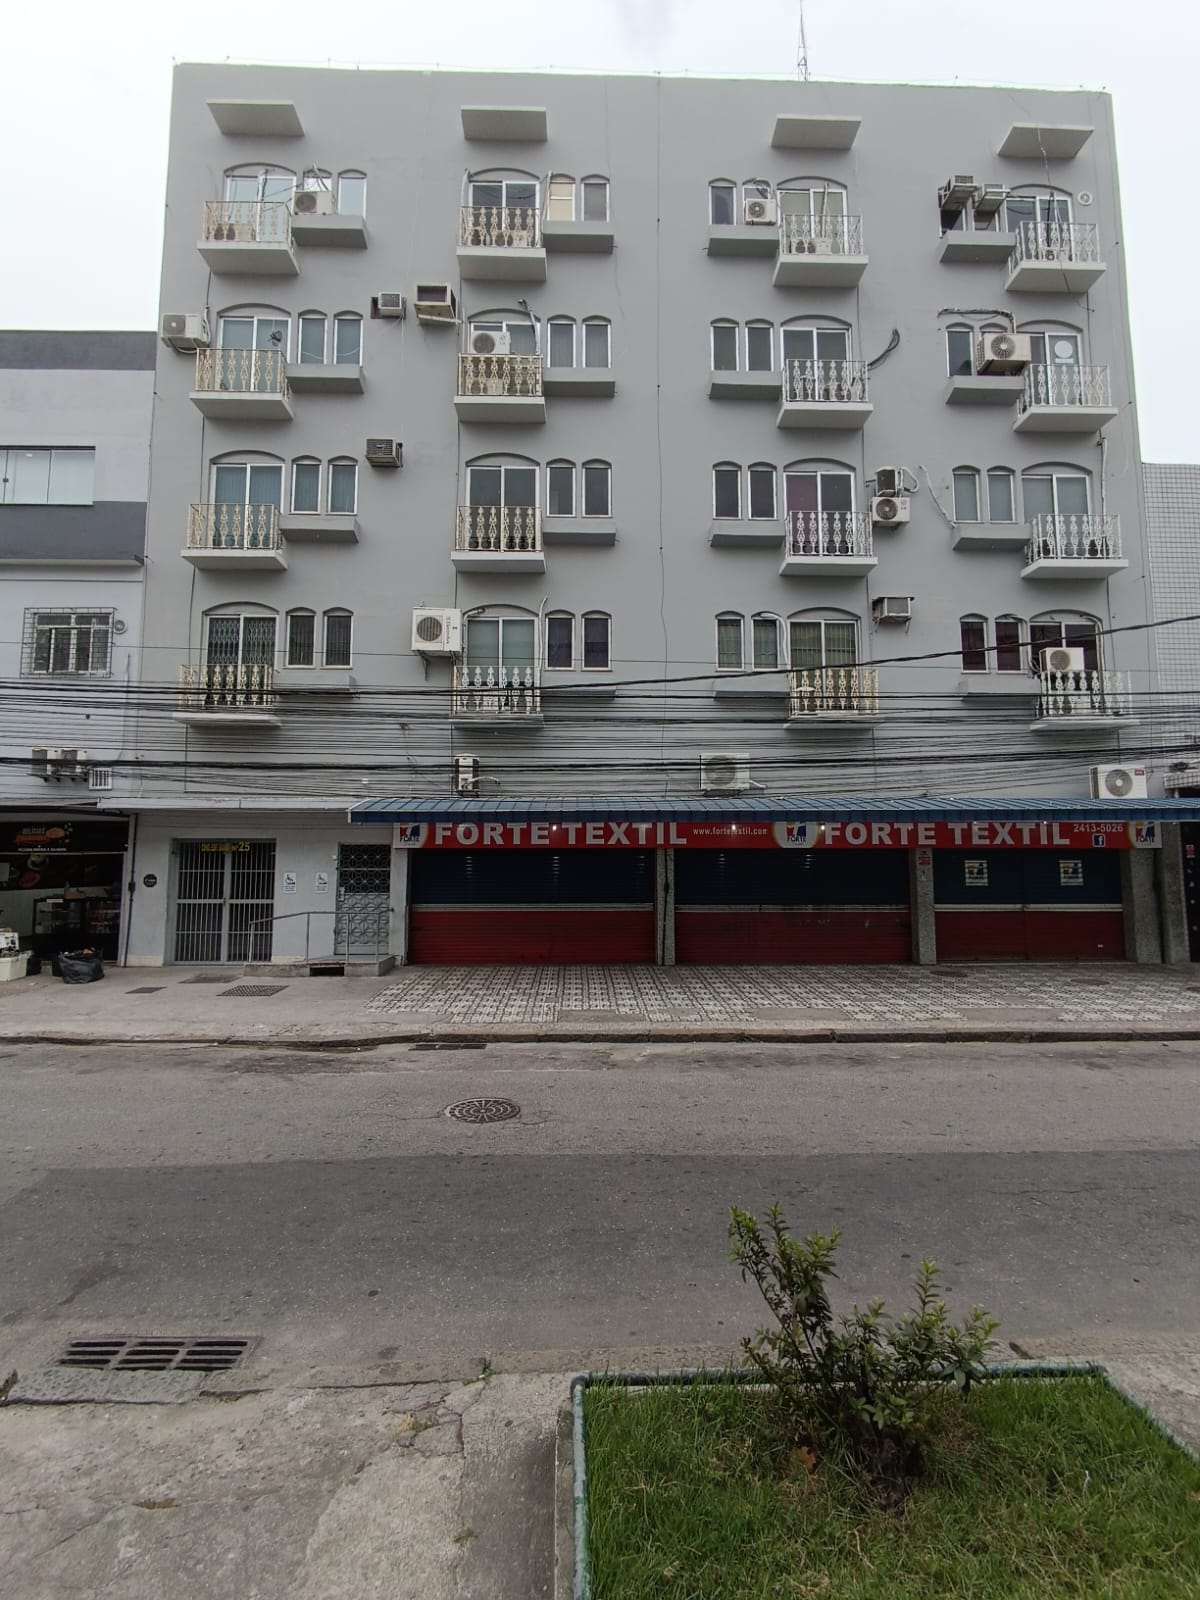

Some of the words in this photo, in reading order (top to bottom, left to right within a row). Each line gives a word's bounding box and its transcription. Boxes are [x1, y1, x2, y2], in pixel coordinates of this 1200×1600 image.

[435, 822, 550, 845] FORTE
[562, 822, 687, 845] TEXTIL
[824, 822, 937, 845] FORTE
[947, 822, 1070, 845] TEXTIL
[1073, 823, 1124, 832] 2413-5026
[239, 840, 250, 852] 25
